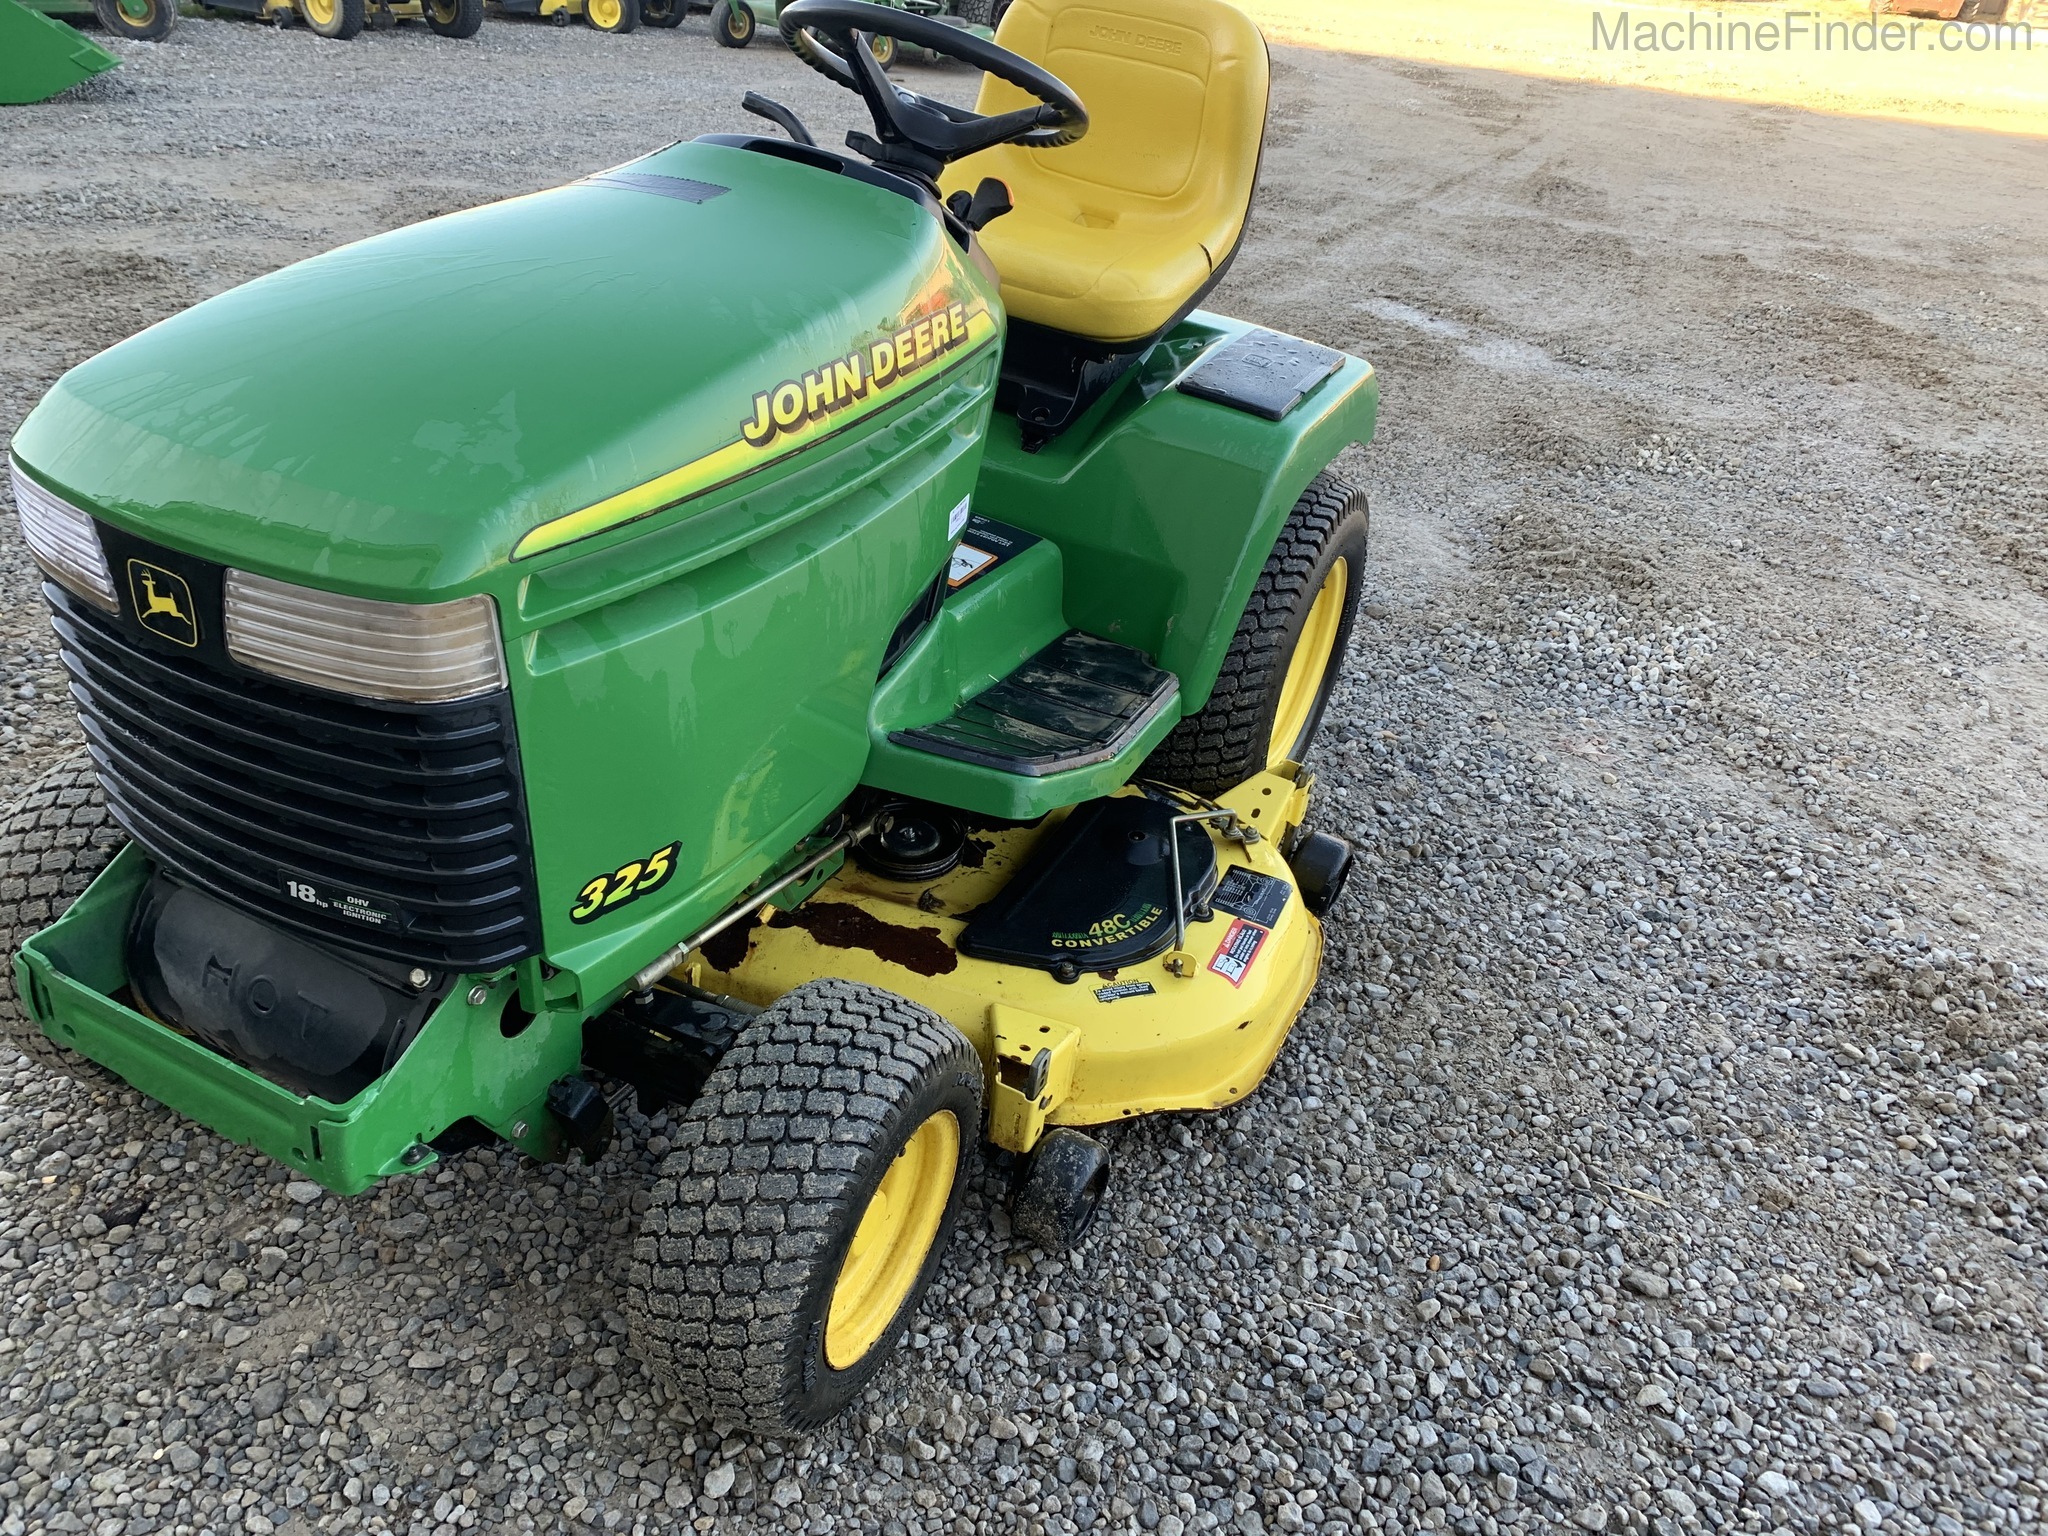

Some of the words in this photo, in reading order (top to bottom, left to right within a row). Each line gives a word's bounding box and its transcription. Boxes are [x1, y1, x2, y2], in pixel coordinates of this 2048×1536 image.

[1134, 33, 1182, 56] DEERE
[740, 351, 866, 446] JOHN
[869, 301, 969, 389] DEERE
[286, 880, 316, 903] 18
[570, 841, 681, 923] 325
[333, 901, 387, 920] ELECTRONIC
[346, 896, 370, 907] OHV
[342, 909, 382, 924] IGNITION
[1051, 906, 1163, 948] CONVERTIBLE
[1088, 913, 1131, 937] 48C
[202, 954, 330, 1039] HOT
